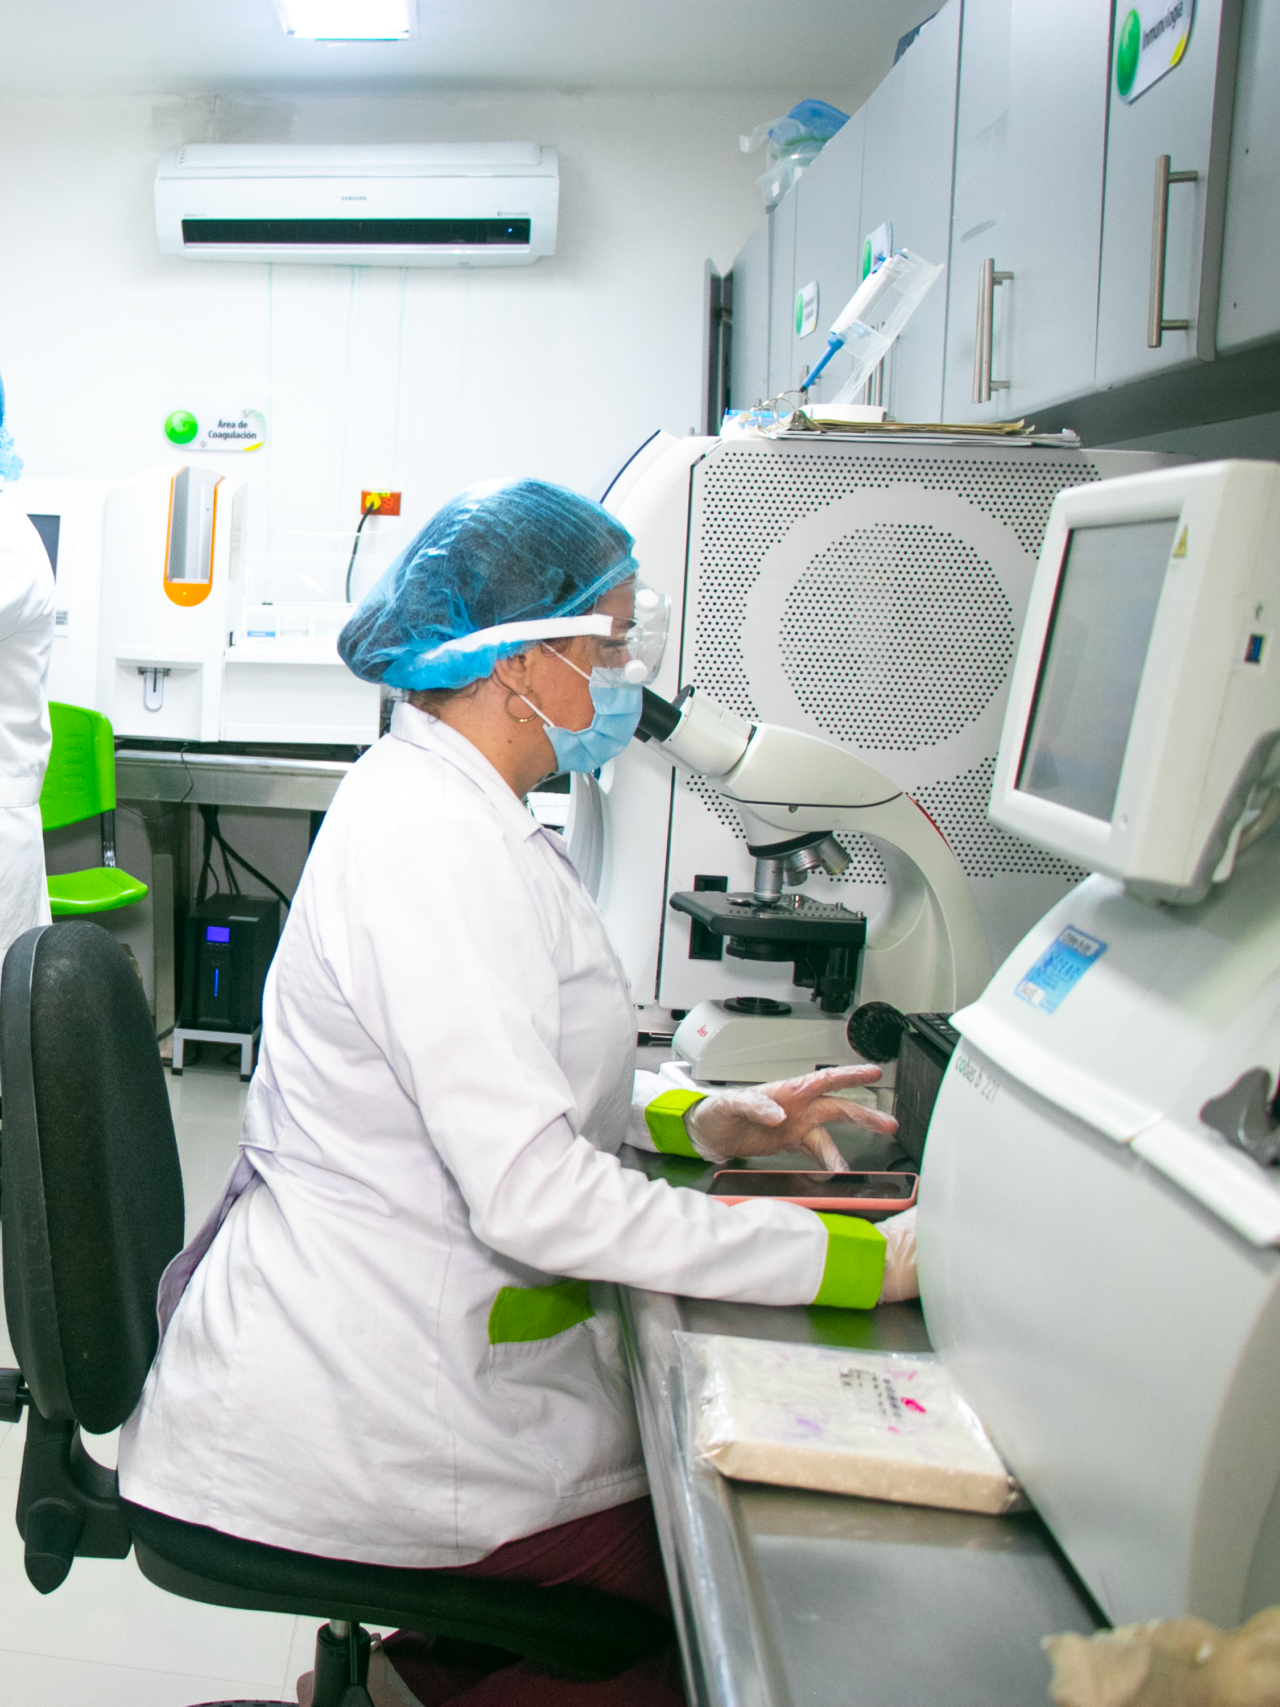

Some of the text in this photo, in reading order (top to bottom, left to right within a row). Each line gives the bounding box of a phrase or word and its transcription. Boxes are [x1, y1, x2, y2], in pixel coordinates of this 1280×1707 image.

[217, 418, 248, 429] Área de
[208, 430, 257, 441] Coagulación
[955, 1055, 1000, 1104] cobas b 221
